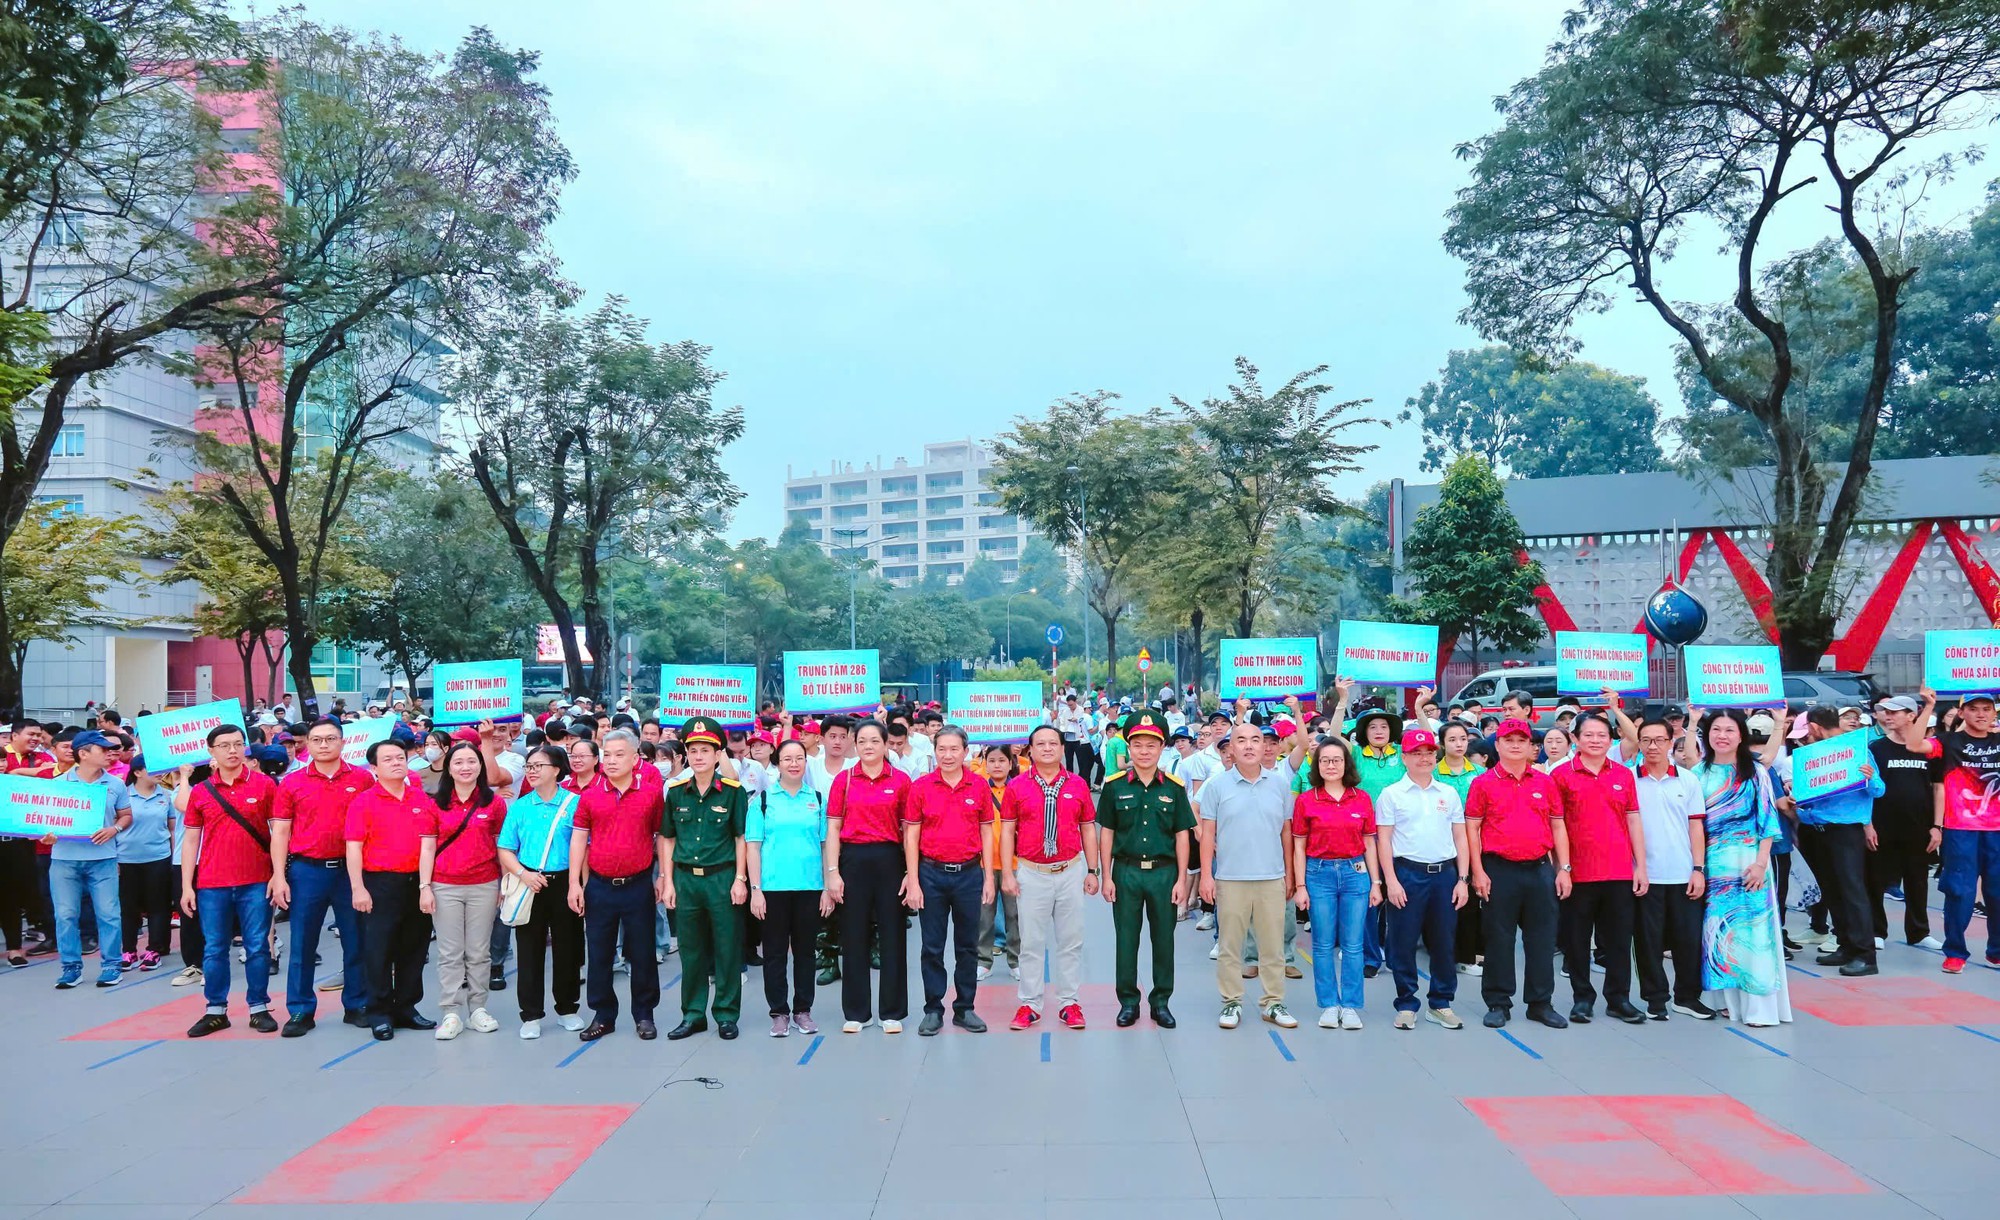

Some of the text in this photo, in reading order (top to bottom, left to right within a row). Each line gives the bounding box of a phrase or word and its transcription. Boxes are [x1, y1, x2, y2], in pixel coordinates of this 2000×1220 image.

[1345, 646, 1374, 660] PHƯỜNG
[1377, 650, 1400, 661] TRUNG
[1416, 651, 1430, 663] TÂY
[1562, 647, 1576, 659] CÔNG
[1577, 649, 1583, 659] TY
[1584, 645, 1591, 660] CỔ
[1592, 647, 1607, 660] PHẦN
[1608, 650, 1623, 661] CÔNG
[1946, 646, 1967, 658] CÔNG
[1970, 648, 1979, 657] TY
[1982, 643, 1992, 658] CỔ
[1234, 654, 1302, 666] CÔNG TY TNHH CNS
[1703, 660, 1764, 674] CÔNG TY CỔ PHẦN
[798, 663, 866, 676] TRUNG TÂM 286
[1576, 668, 1596, 680] THƯƠNG
[1598, 670, 1608, 682] MẠI
[1620, 670, 1634, 684] NGHỊ
[1952, 667, 1974, 680] NHỰA
[1977, 665, 1990, 678] SÀI
[446, 677, 507, 691] CÔNG TY TNHH MTV
[676, 677, 695, 686] CÔNG
[706, 678, 724, 687] TNHH
[726, 679, 741, 688] MTV
[1235, 675, 1303, 687] AMURA PRECISION
[1702, 681, 1769, 694] CAO SU BẾN THÀNH
[802, 682, 865, 697] BỘ TƯ LỆNH 86
[446, 696, 510, 711] CAO SU THỐNG NHẤT
[668, 691, 747, 703] PHÁT TRIỂN CÔNG VIÊN
[970, 694, 985, 702] CÔNG
[664, 706, 751, 718] PHẦN MỀM QUANG TRUNG
[951, 709, 965, 717] PHÁT
[967, 708, 982, 718] TRIỂN
[996, 709, 1011, 717] CÔNG
[1013, 709, 1027, 719] NGHỆ
[162, 716, 222, 738] NHÀ MÁY CNS
[982, 723, 993, 732] PHỐ
[1003, 723, 1012, 732] CHÍ
[169, 742, 199, 755] THẠNH
[1805, 757, 1820, 771] CÔNG
[1821, 756, 1827, 766] TY
[1818, 773, 1828, 785] KHÍ
[1829, 770, 1847, 782] SINCO
[11, 792, 91, 810] NHÀ MÁY THUỐC LÁ
[25, 812, 73, 827] BẾN THÀNH
